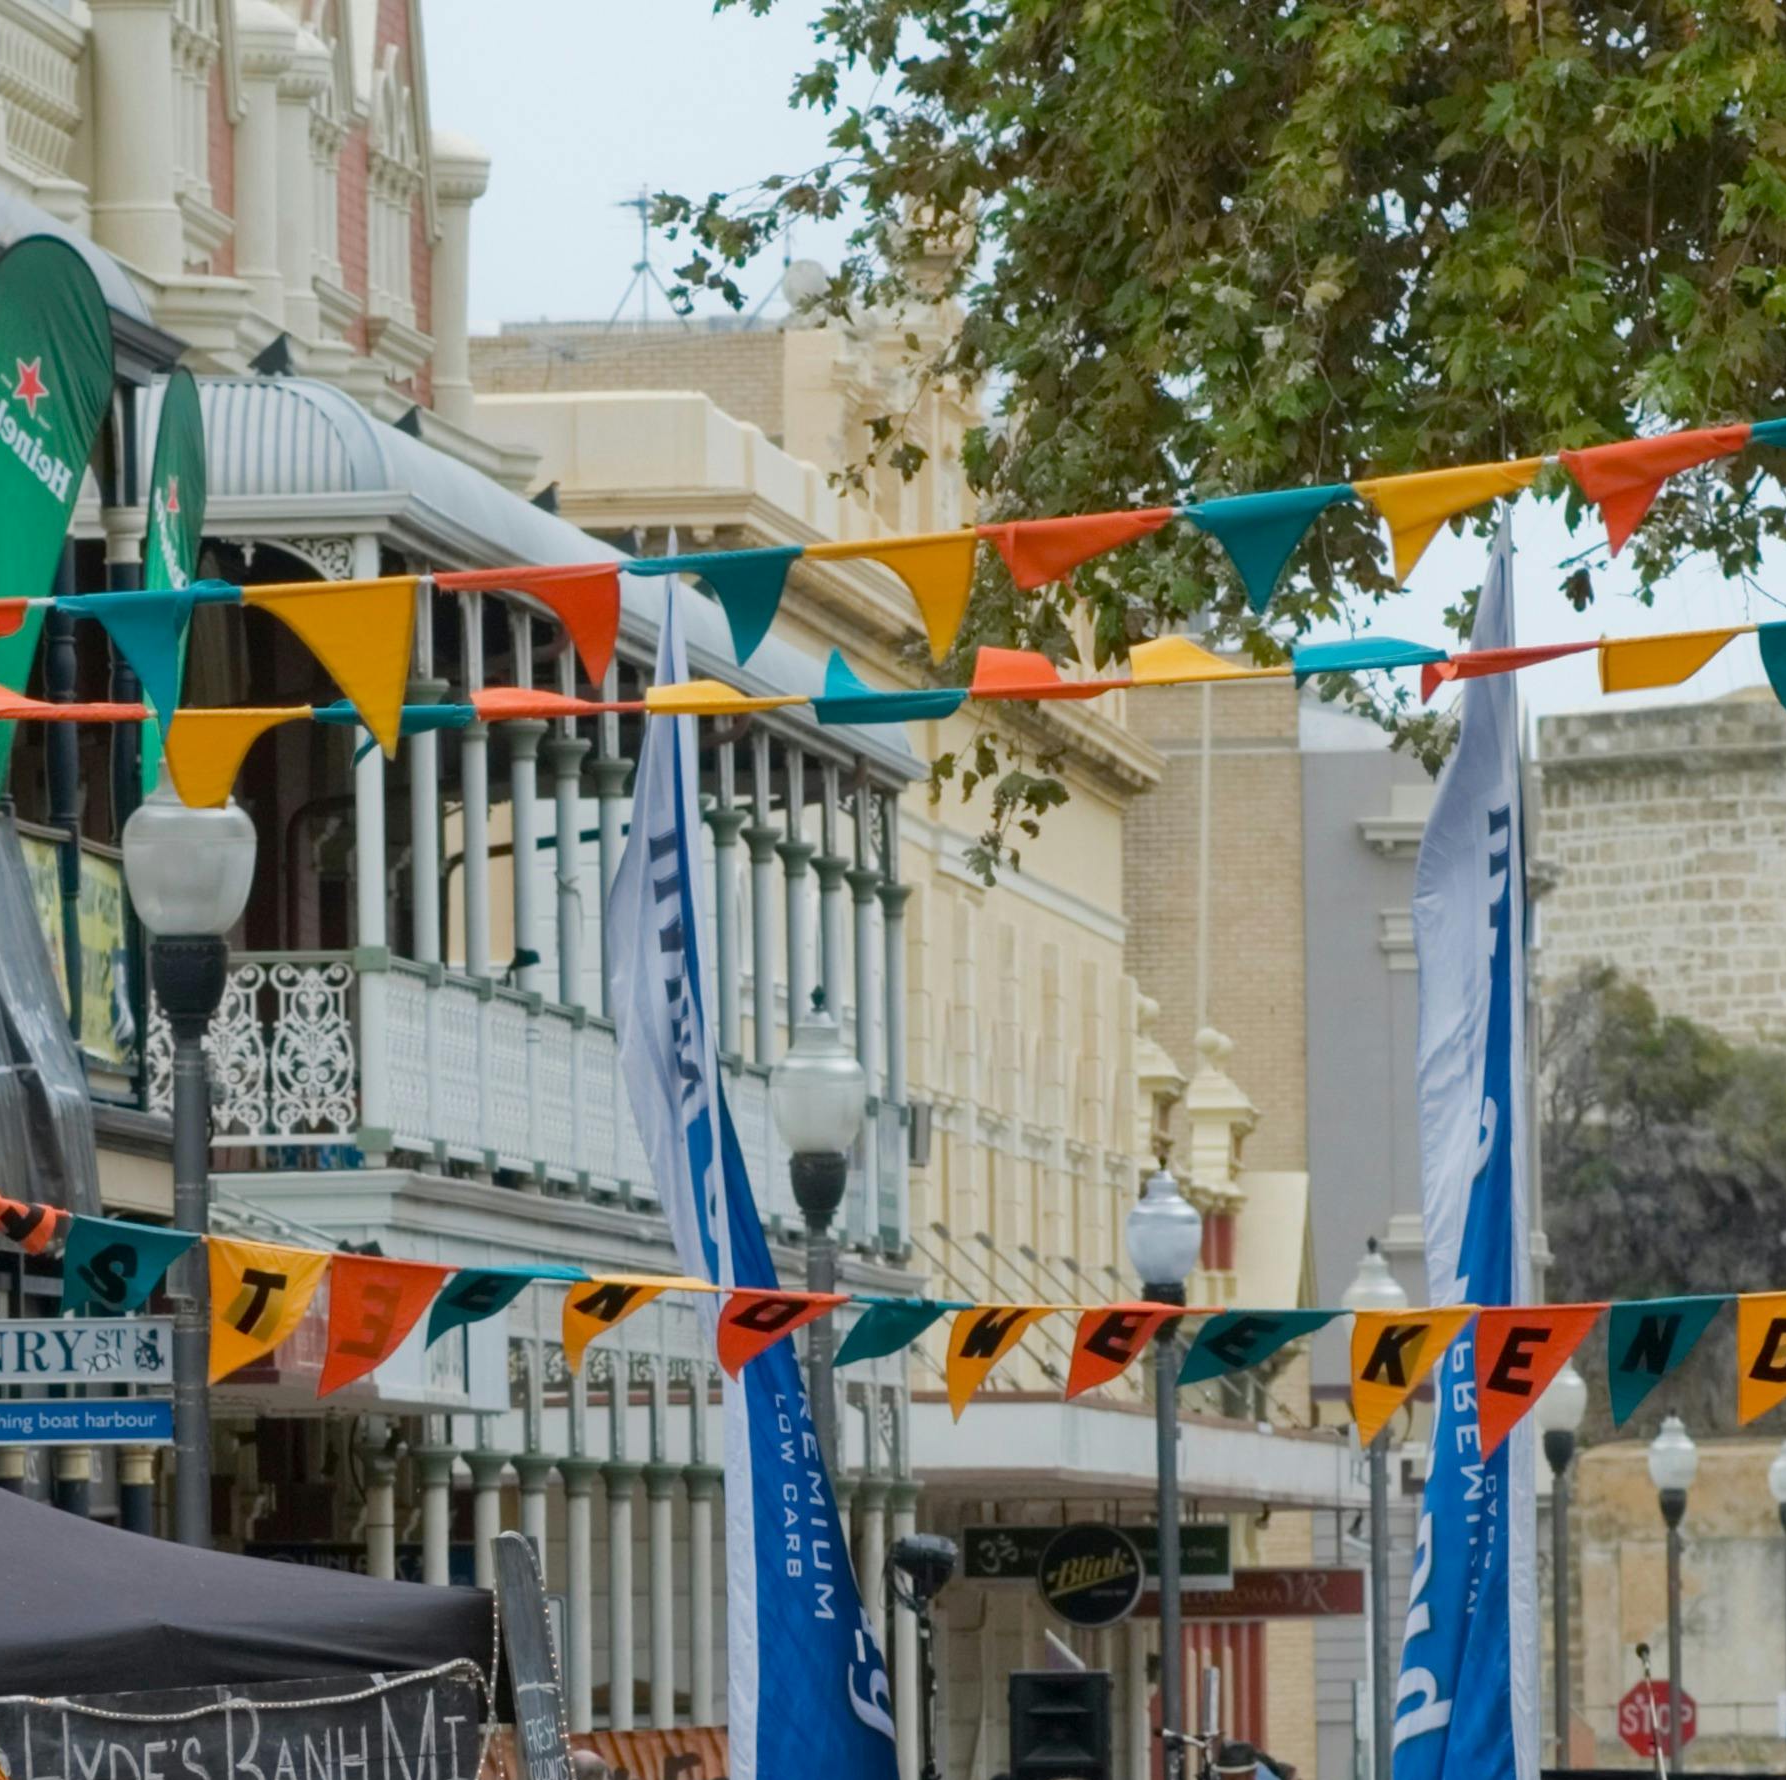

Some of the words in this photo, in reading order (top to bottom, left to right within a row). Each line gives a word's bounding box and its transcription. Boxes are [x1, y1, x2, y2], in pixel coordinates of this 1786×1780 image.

[95, 1328, 127, 1351] ST
[39, 1411, 79, 1429] boat
[85, 1411, 157, 1428] harbour
[774, 1394, 797, 1465] LOW
[782, 1483, 802, 1578] CARB
[1055, 1547, 1130, 1588] Blink
[525, 1714, 558, 1754] FRESH
[1621, 1703, 1694, 1735] STOP
